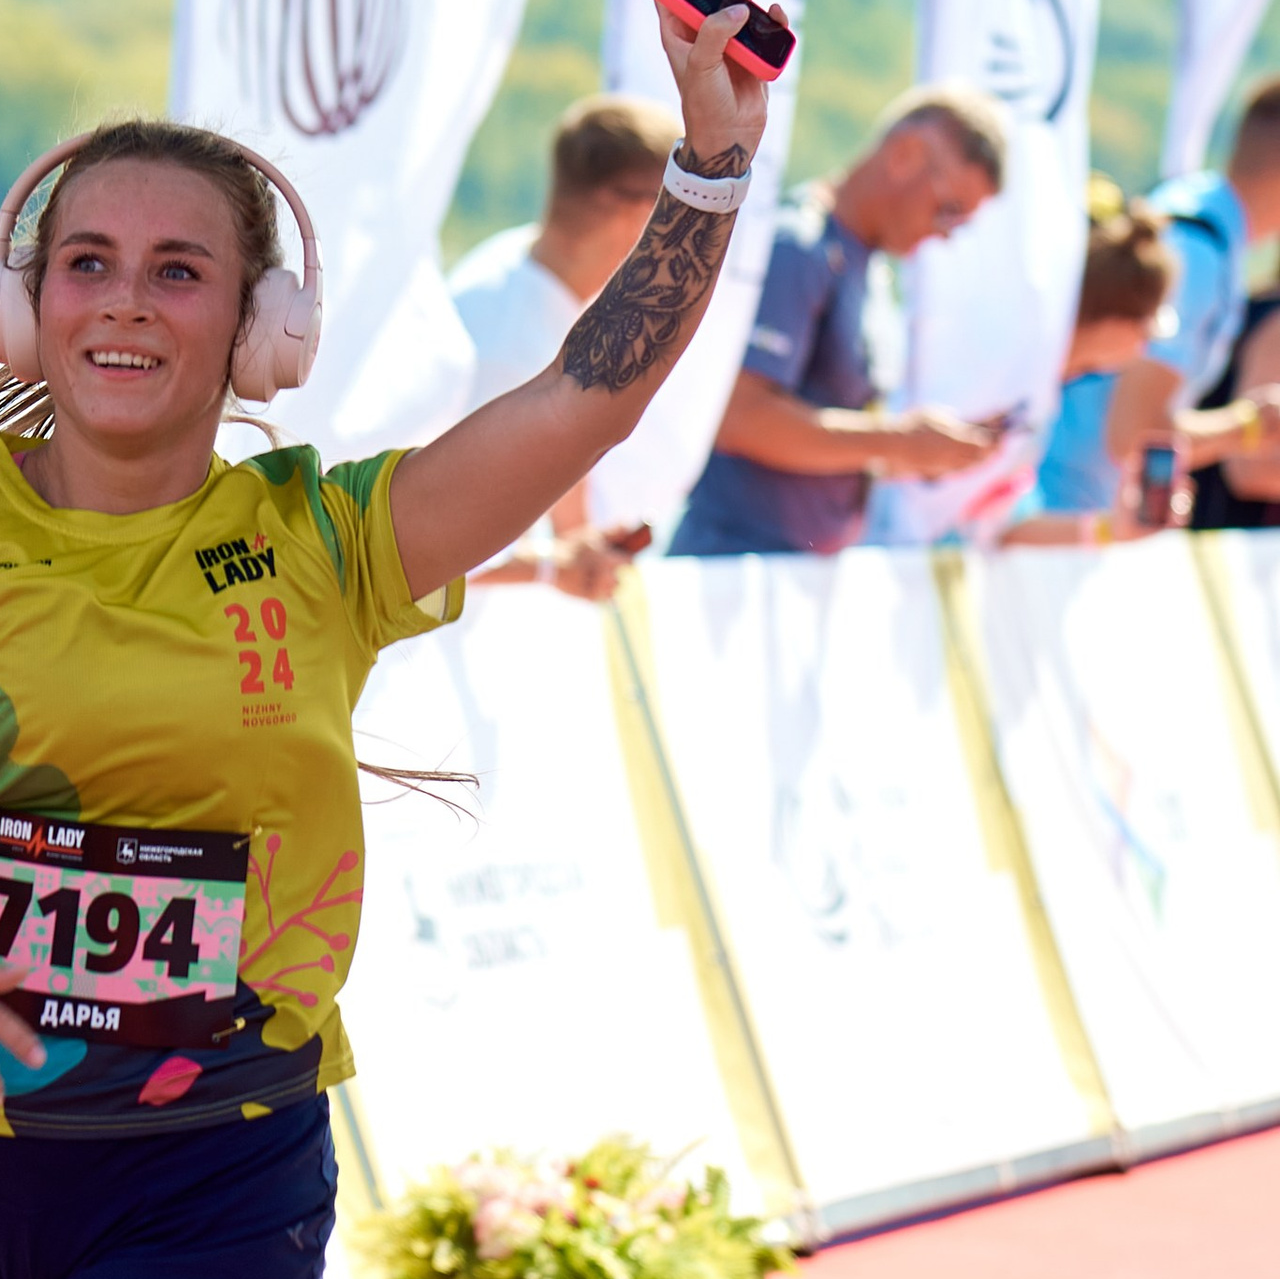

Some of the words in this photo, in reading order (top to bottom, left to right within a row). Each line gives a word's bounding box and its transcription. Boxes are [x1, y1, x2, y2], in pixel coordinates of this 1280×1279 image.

[195, 537, 251, 570] IRON
[204, 546, 277, 595] LADY
[224, 597, 287, 643] 20
[238, 648, 295, 694] 24
[0, 816, 32, 841] IRON
[47, 825, 85, 849] LADY
[40, 999, 121, 1030] ДАРЬЯ
